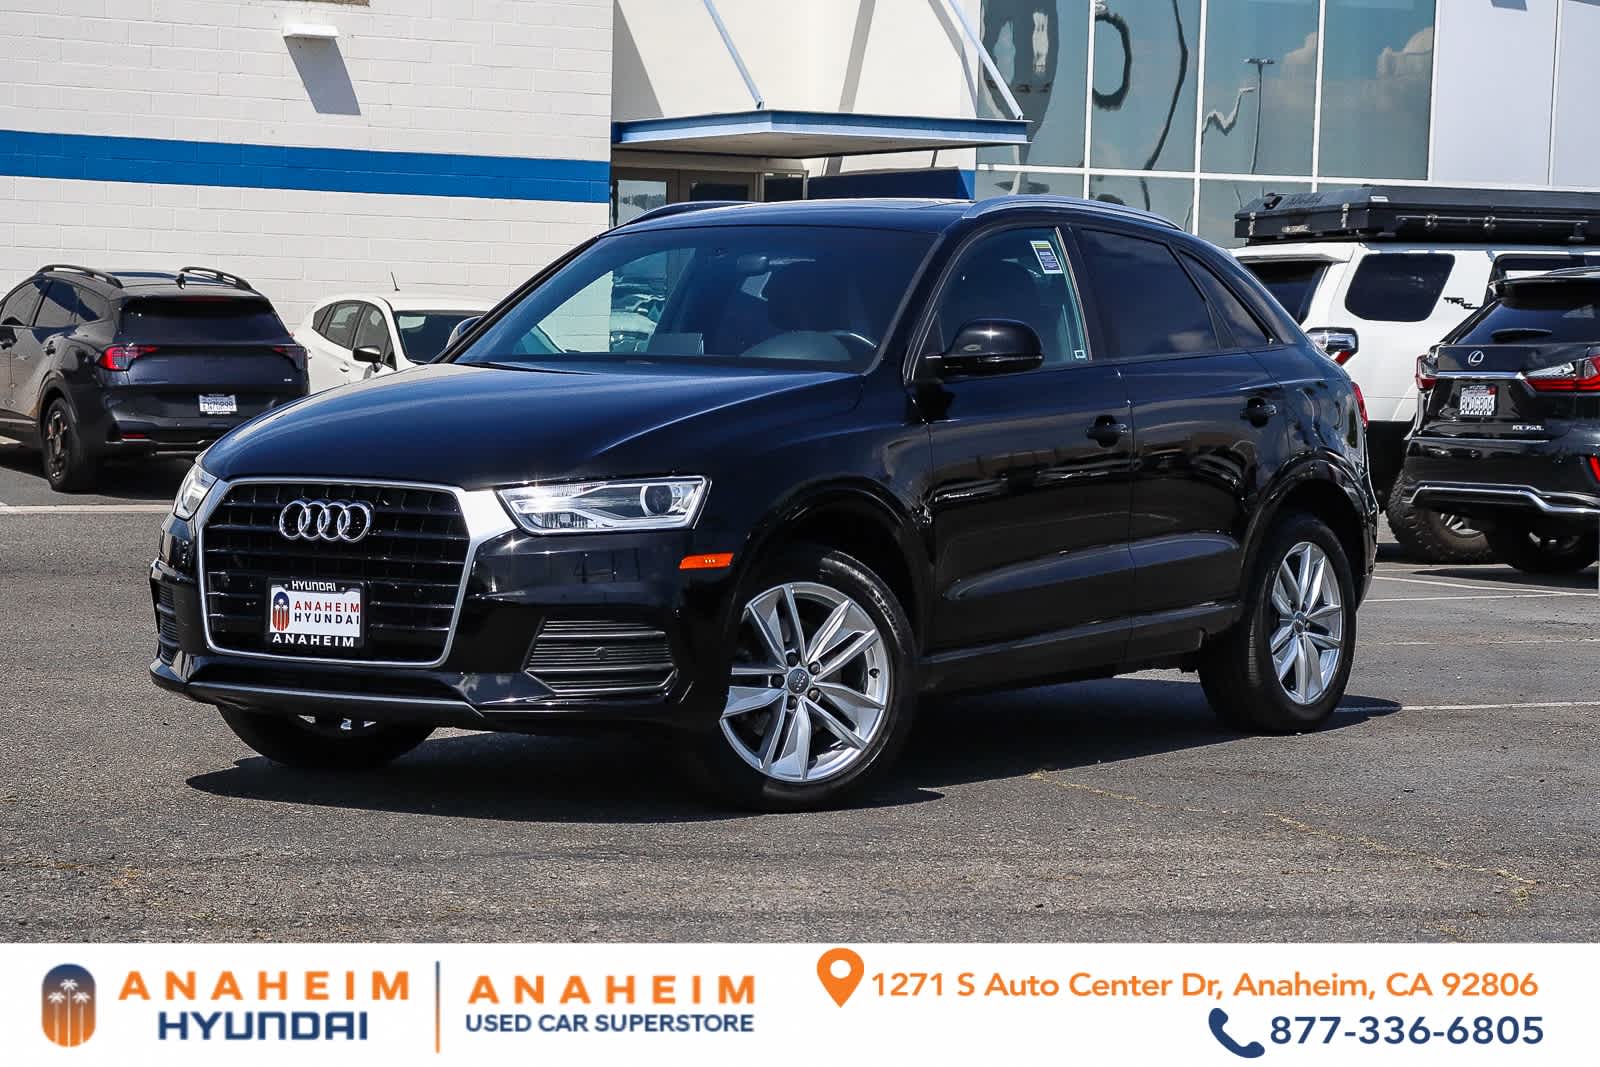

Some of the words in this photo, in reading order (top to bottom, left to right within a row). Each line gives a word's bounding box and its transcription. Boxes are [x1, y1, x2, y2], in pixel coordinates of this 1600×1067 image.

[291, 580, 337, 592] HYUNDAI
[294, 600, 360, 613] ANAHEIM
[294, 612, 360, 625] HYUNDAI
[272, 633, 355, 647] ANAHEIM
